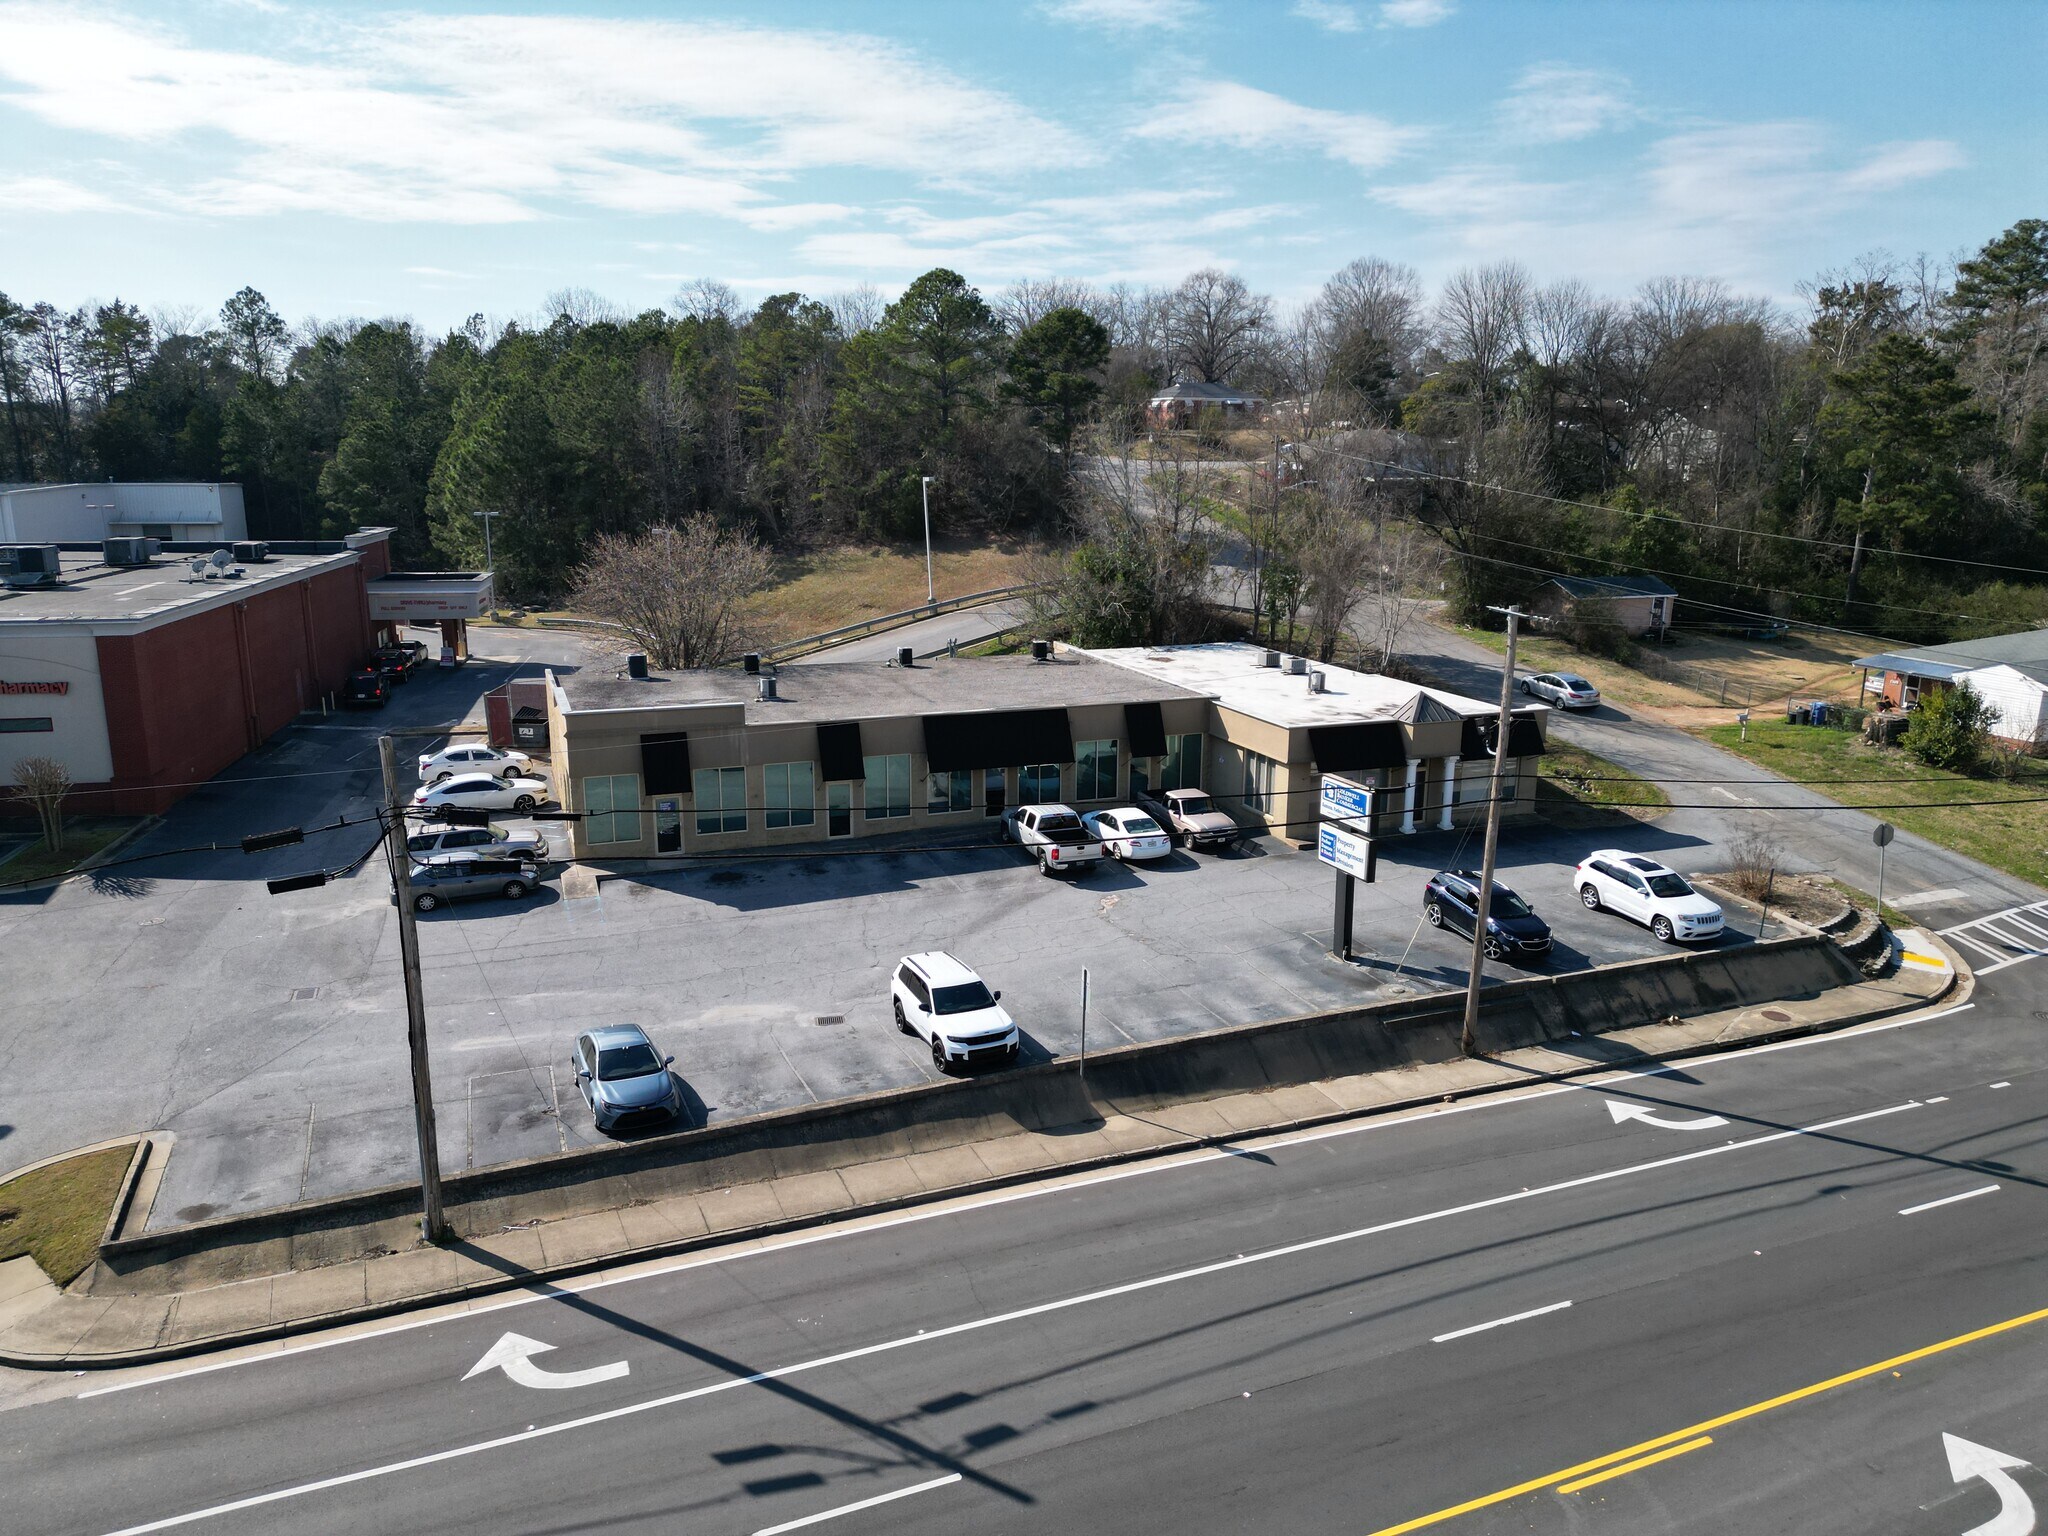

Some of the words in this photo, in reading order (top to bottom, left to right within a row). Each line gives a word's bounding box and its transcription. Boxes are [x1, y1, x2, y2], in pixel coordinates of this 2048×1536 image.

[1337, 793, 1354, 803] BANKER
[1338, 788, 1360, 800] COLDWELL
[1336, 798, 1364, 813] COMMERCIAL
[1338, 837, 1355, 850] Property
[1336, 847, 1364, 864] Management
[1337, 857, 1354, 869] Division
